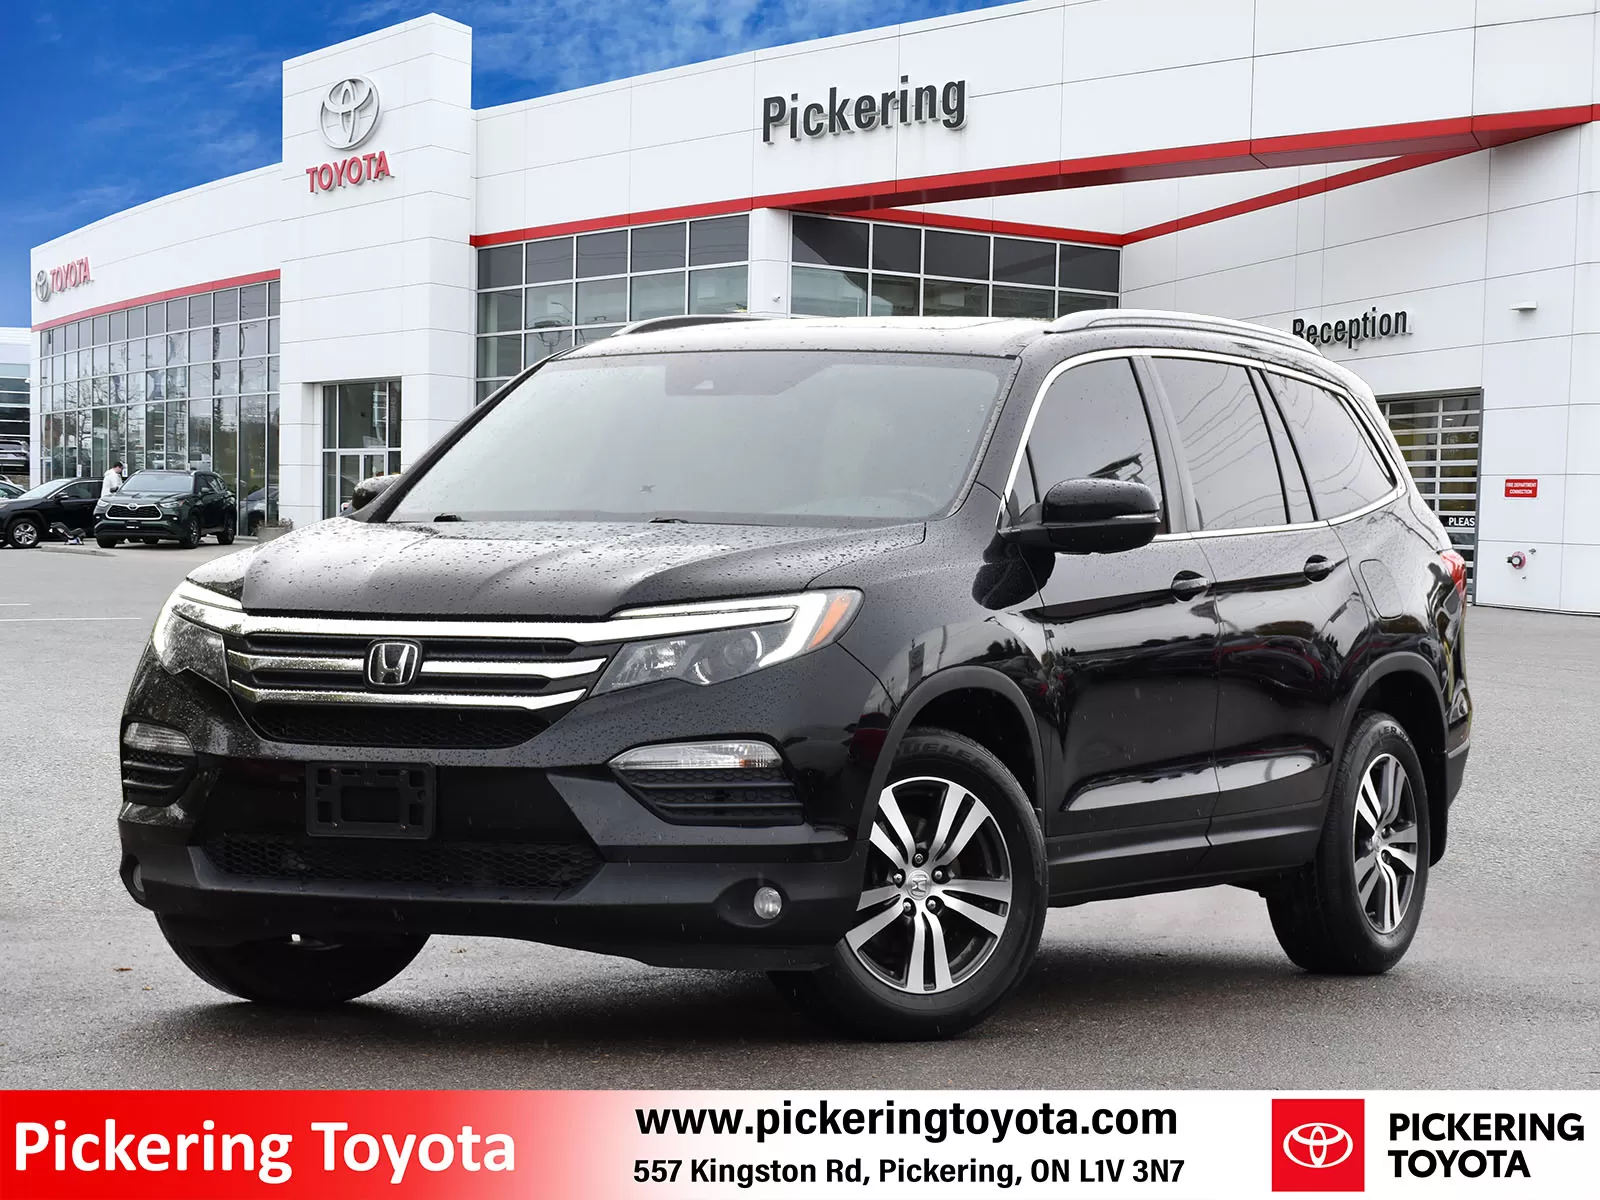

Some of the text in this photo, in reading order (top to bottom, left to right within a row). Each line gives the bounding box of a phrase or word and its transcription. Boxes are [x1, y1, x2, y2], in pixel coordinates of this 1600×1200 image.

[762, 75, 967, 145] Pickering
[306, 151, 390, 193] TOYOTA
[50, 256, 91, 293] TOYOTA
[1292, 306, 1408, 349] Reception
